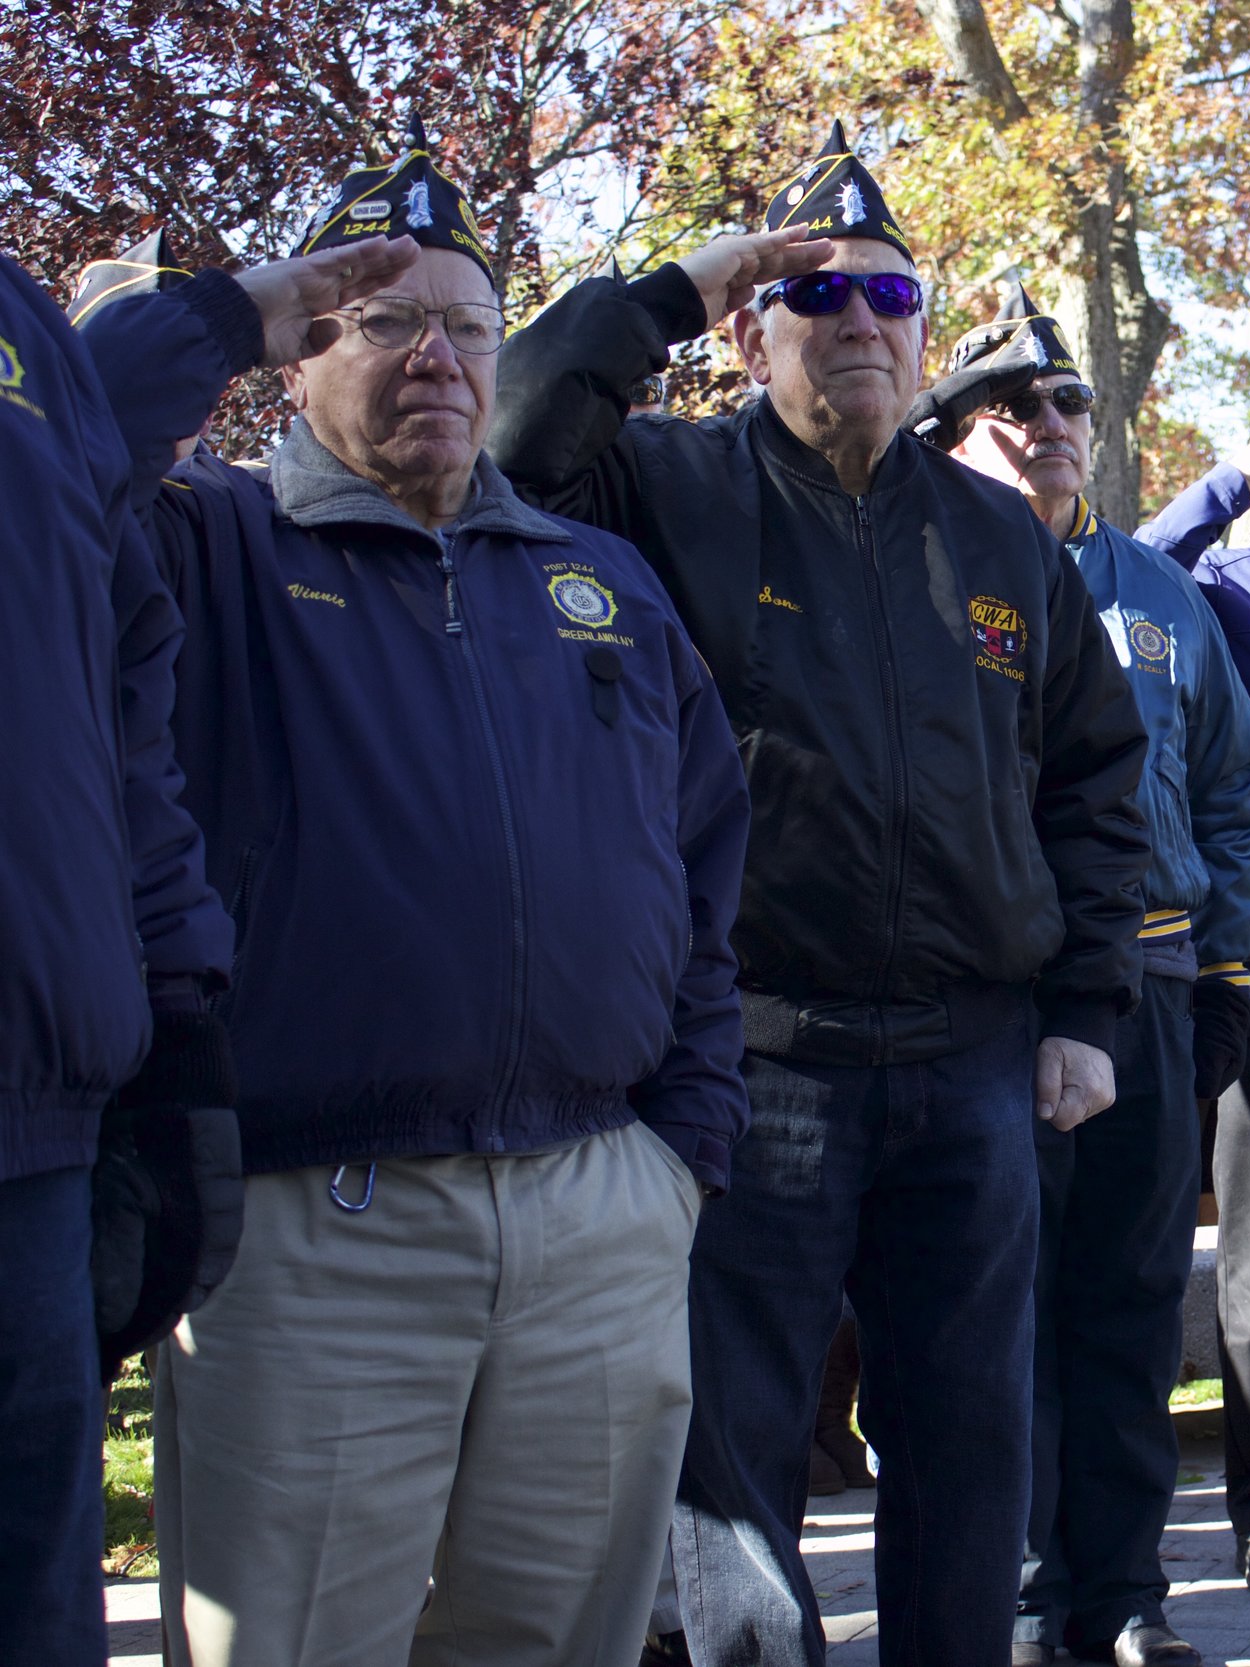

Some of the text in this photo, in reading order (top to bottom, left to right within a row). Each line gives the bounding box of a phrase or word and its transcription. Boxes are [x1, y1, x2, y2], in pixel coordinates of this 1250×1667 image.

[343, 220, 391, 235] 1244
[543, 562, 594, 573] POST 1244
[287, 583, 346, 608] Vinnie
[973, 604, 1015, 630] CWA
[975, 655, 1025, 682] OCAL 1106
